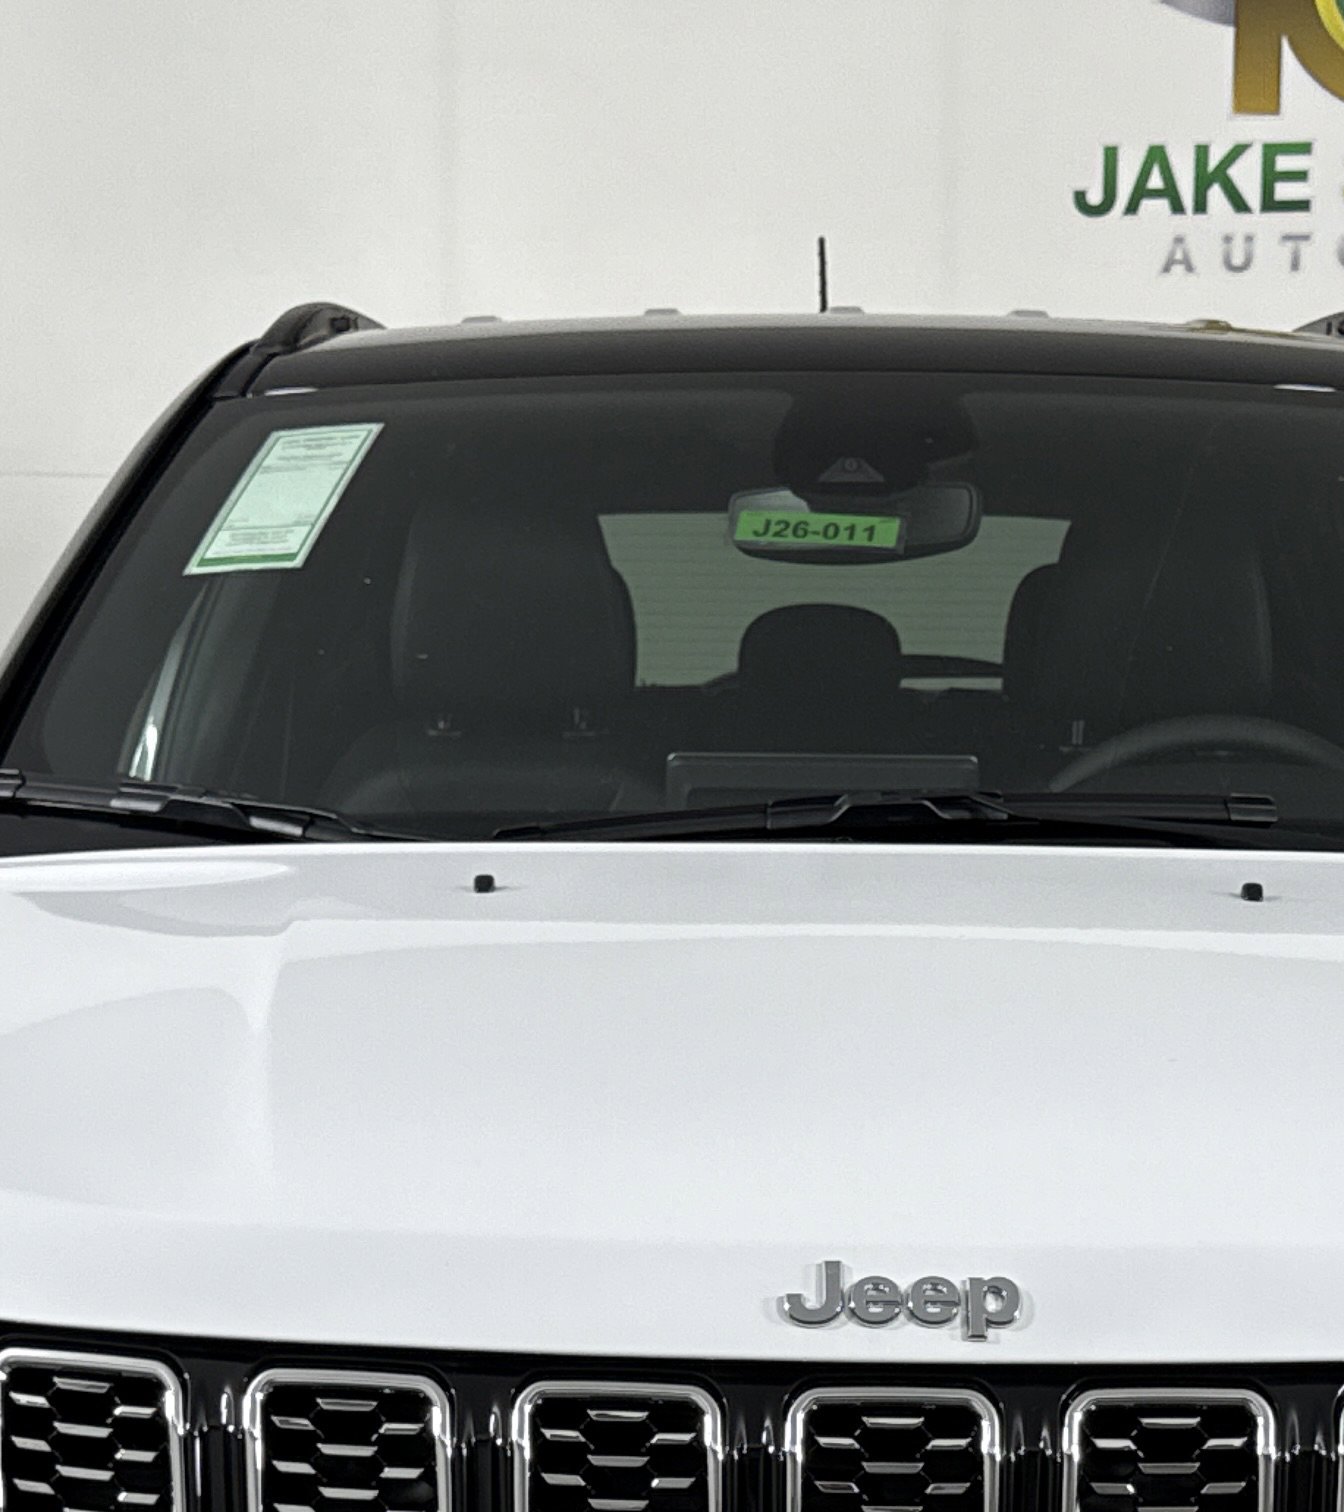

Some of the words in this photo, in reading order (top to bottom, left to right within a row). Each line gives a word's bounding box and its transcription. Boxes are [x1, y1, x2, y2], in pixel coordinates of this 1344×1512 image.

[1072, 141, 1312, 217] JAKE
[752, 519, 877, 542] J26-011
[783, 1260, 1020, 1342] Jeep
